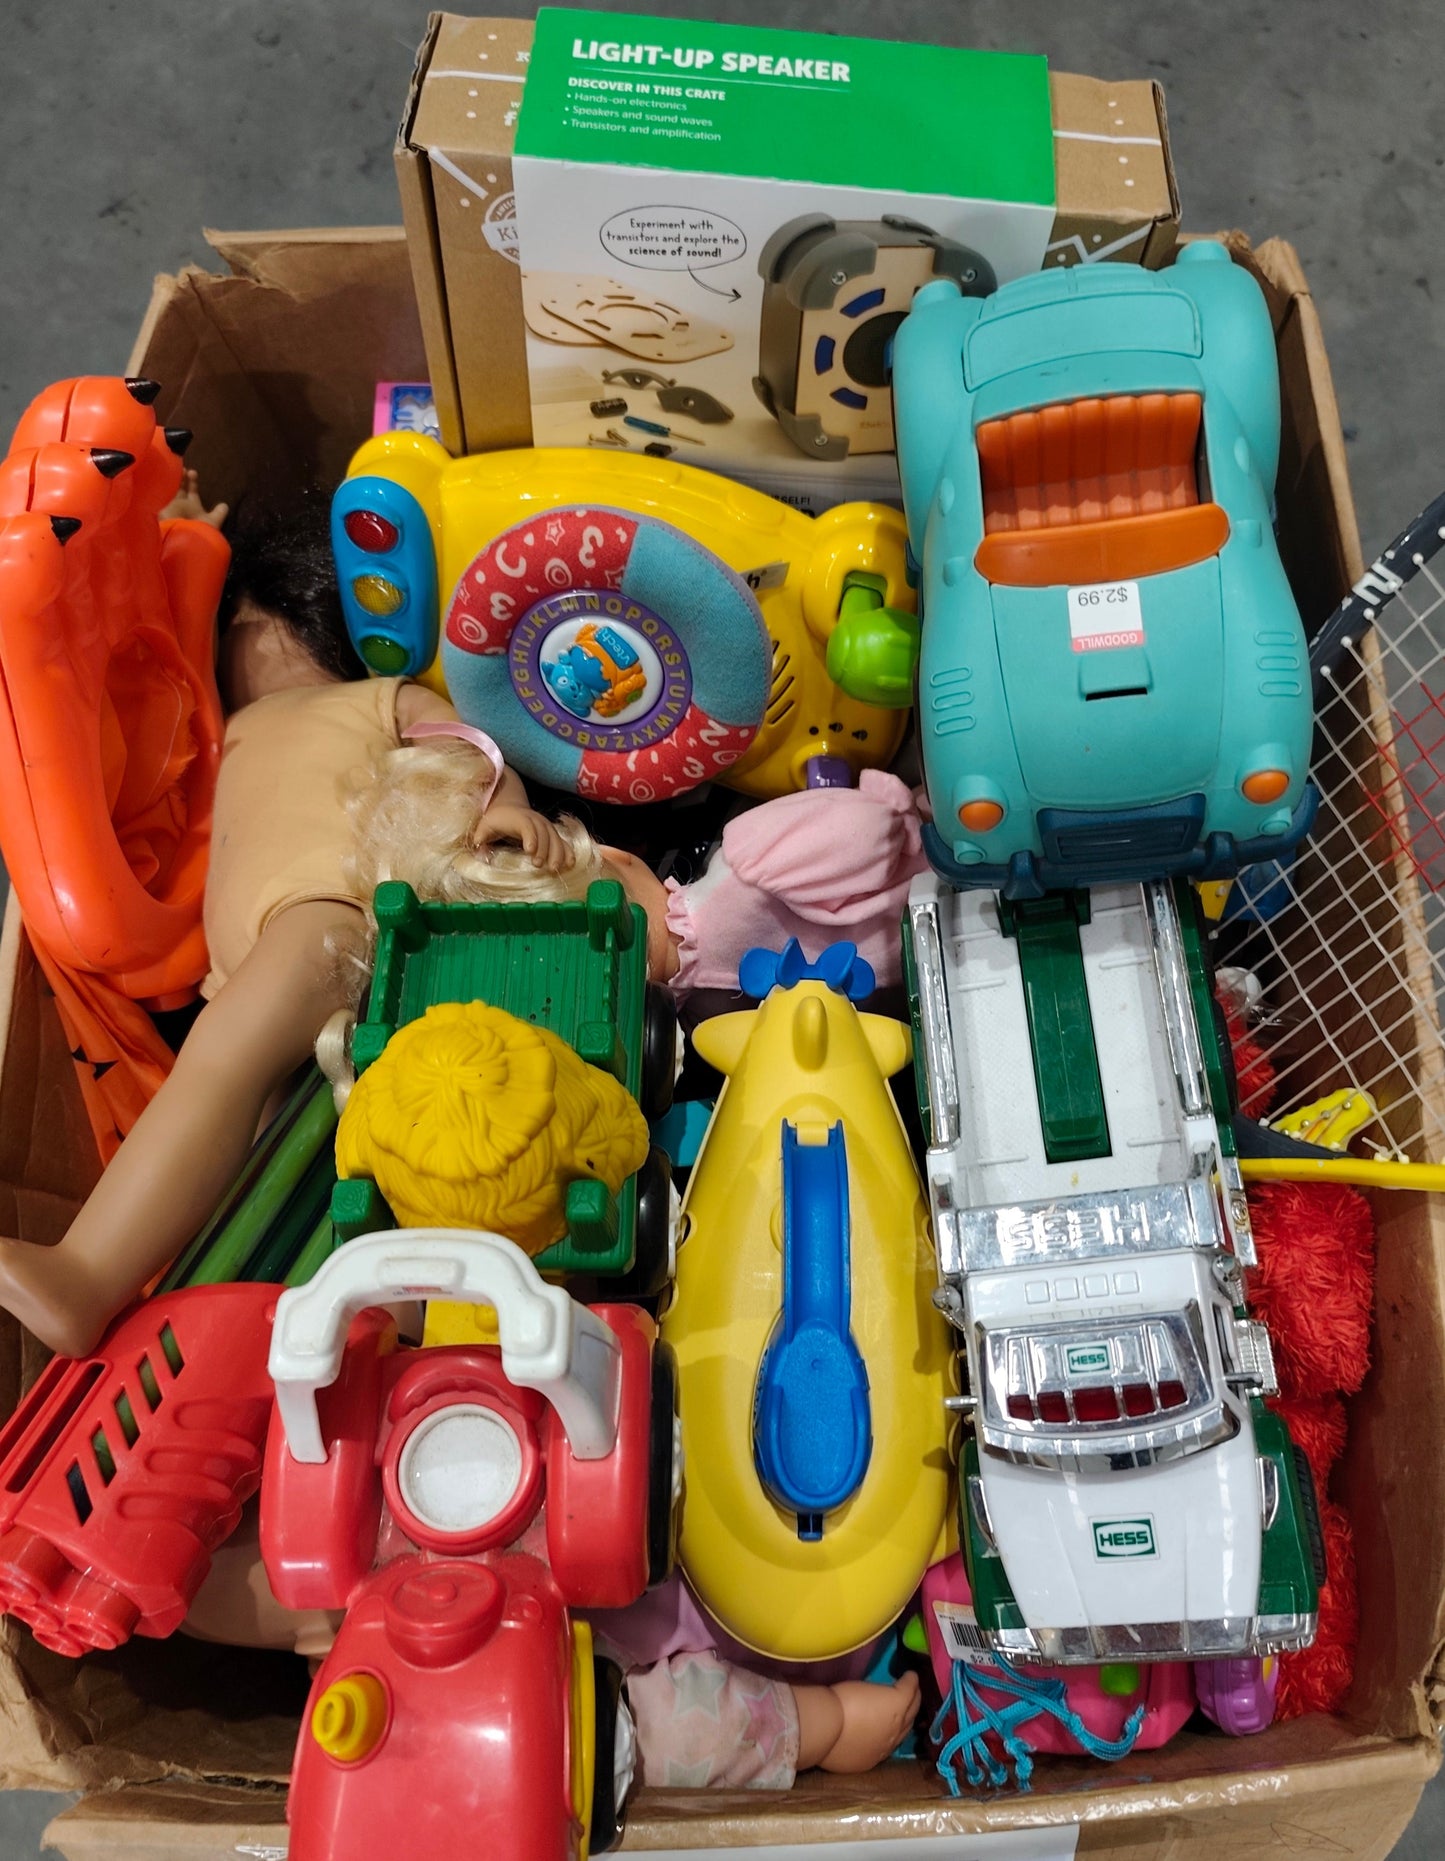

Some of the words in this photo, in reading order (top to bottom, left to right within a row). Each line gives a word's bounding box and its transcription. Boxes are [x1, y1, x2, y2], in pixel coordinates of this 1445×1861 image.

[572, 39, 714, 69] LIGHT-UP
[721, 51, 851, 82] SPEAKER
[568, 77, 633, 92] DISCOVER
[636, 83, 650, 94] IN
[653, 85, 682, 97] THIS
[685, 88, 726, 101] CRATE
[574, 92, 627, 105] Hands-on
[629, 98, 687, 111] electronics
[573, 105, 619, 118] Speakers
[622, 111, 643, 120] and
[645, 113, 678, 124] sound
[680, 116, 713, 127] waves
[571, 118, 627, 133] Transistors
[629, 125, 650, 135] and
[652, 128, 721, 142] amplification
[630, 218, 685, 232] Experiment
[689, 219, 713, 230] with
[607, 231, 659, 242] transistors
[662, 234, 681, 243] and
[684, 234, 718, 247] explore
[722, 234, 739, 245] the
[629, 247, 667, 256] science
[671, 246, 683, 257] of
[687, 248, 722, 258] sound!
[1077, 586, 1128, 607] $2.99
[601, 627, 630, 665] vtech
[1077, 632, 1138, 650] GOODWILL
[1071, 1353, 1105, 1366] HESS
[1099, 1531, 1149, 1547] HESS
